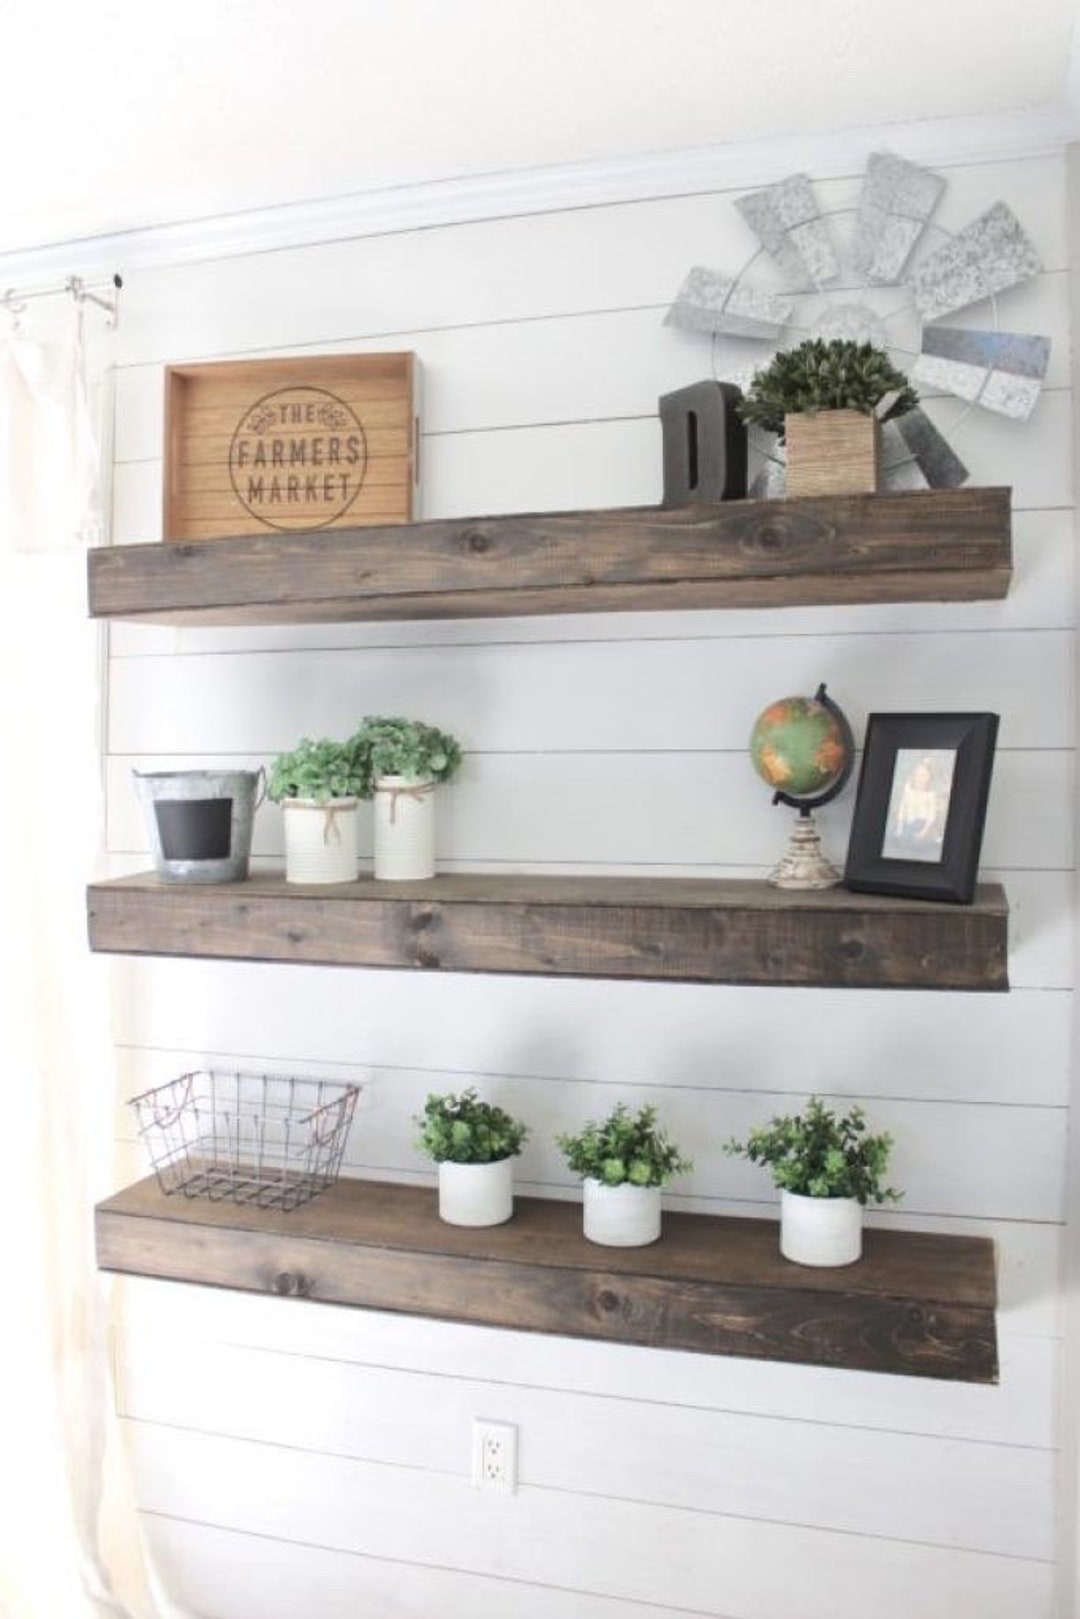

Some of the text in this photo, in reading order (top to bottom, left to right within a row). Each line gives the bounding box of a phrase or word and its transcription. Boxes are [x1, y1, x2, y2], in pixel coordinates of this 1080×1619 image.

[279, 404, 317, 424] THE
[237, 436, 360, 469] FARMERS
[248, 473, 351, 504] MARKET
